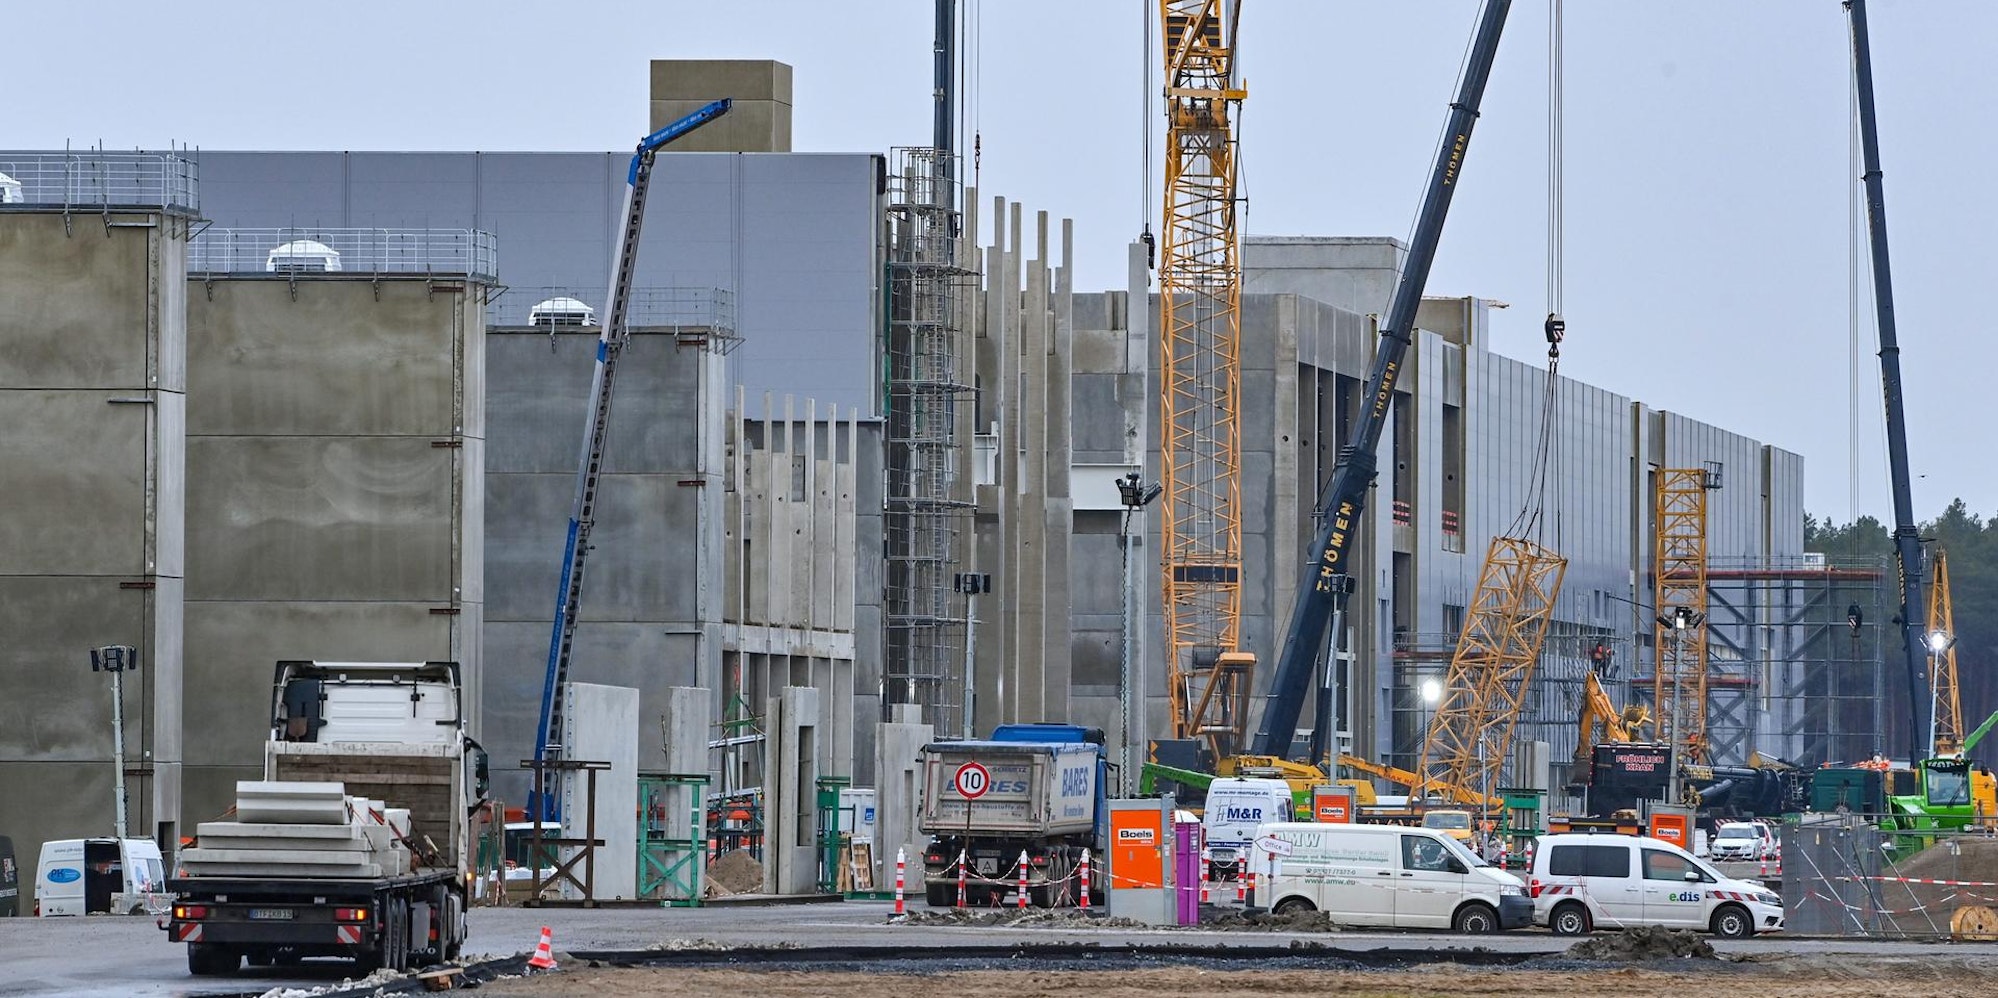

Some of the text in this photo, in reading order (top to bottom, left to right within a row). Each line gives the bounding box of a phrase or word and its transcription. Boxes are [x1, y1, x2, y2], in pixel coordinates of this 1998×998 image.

[1616, 754, 1664, 763] FRÖHLICH
[1625, 763, 1654, 771] KRAN
[945, 780, 1028, 792] BRES
[963, 772, 982, 789] 10
[1062, 767, 1089, 797] BARES
[1227, 808, 1262, 819] M&R
[982, 861, 993, 871] A
[1669, 891, 1700, 902] e.dis
